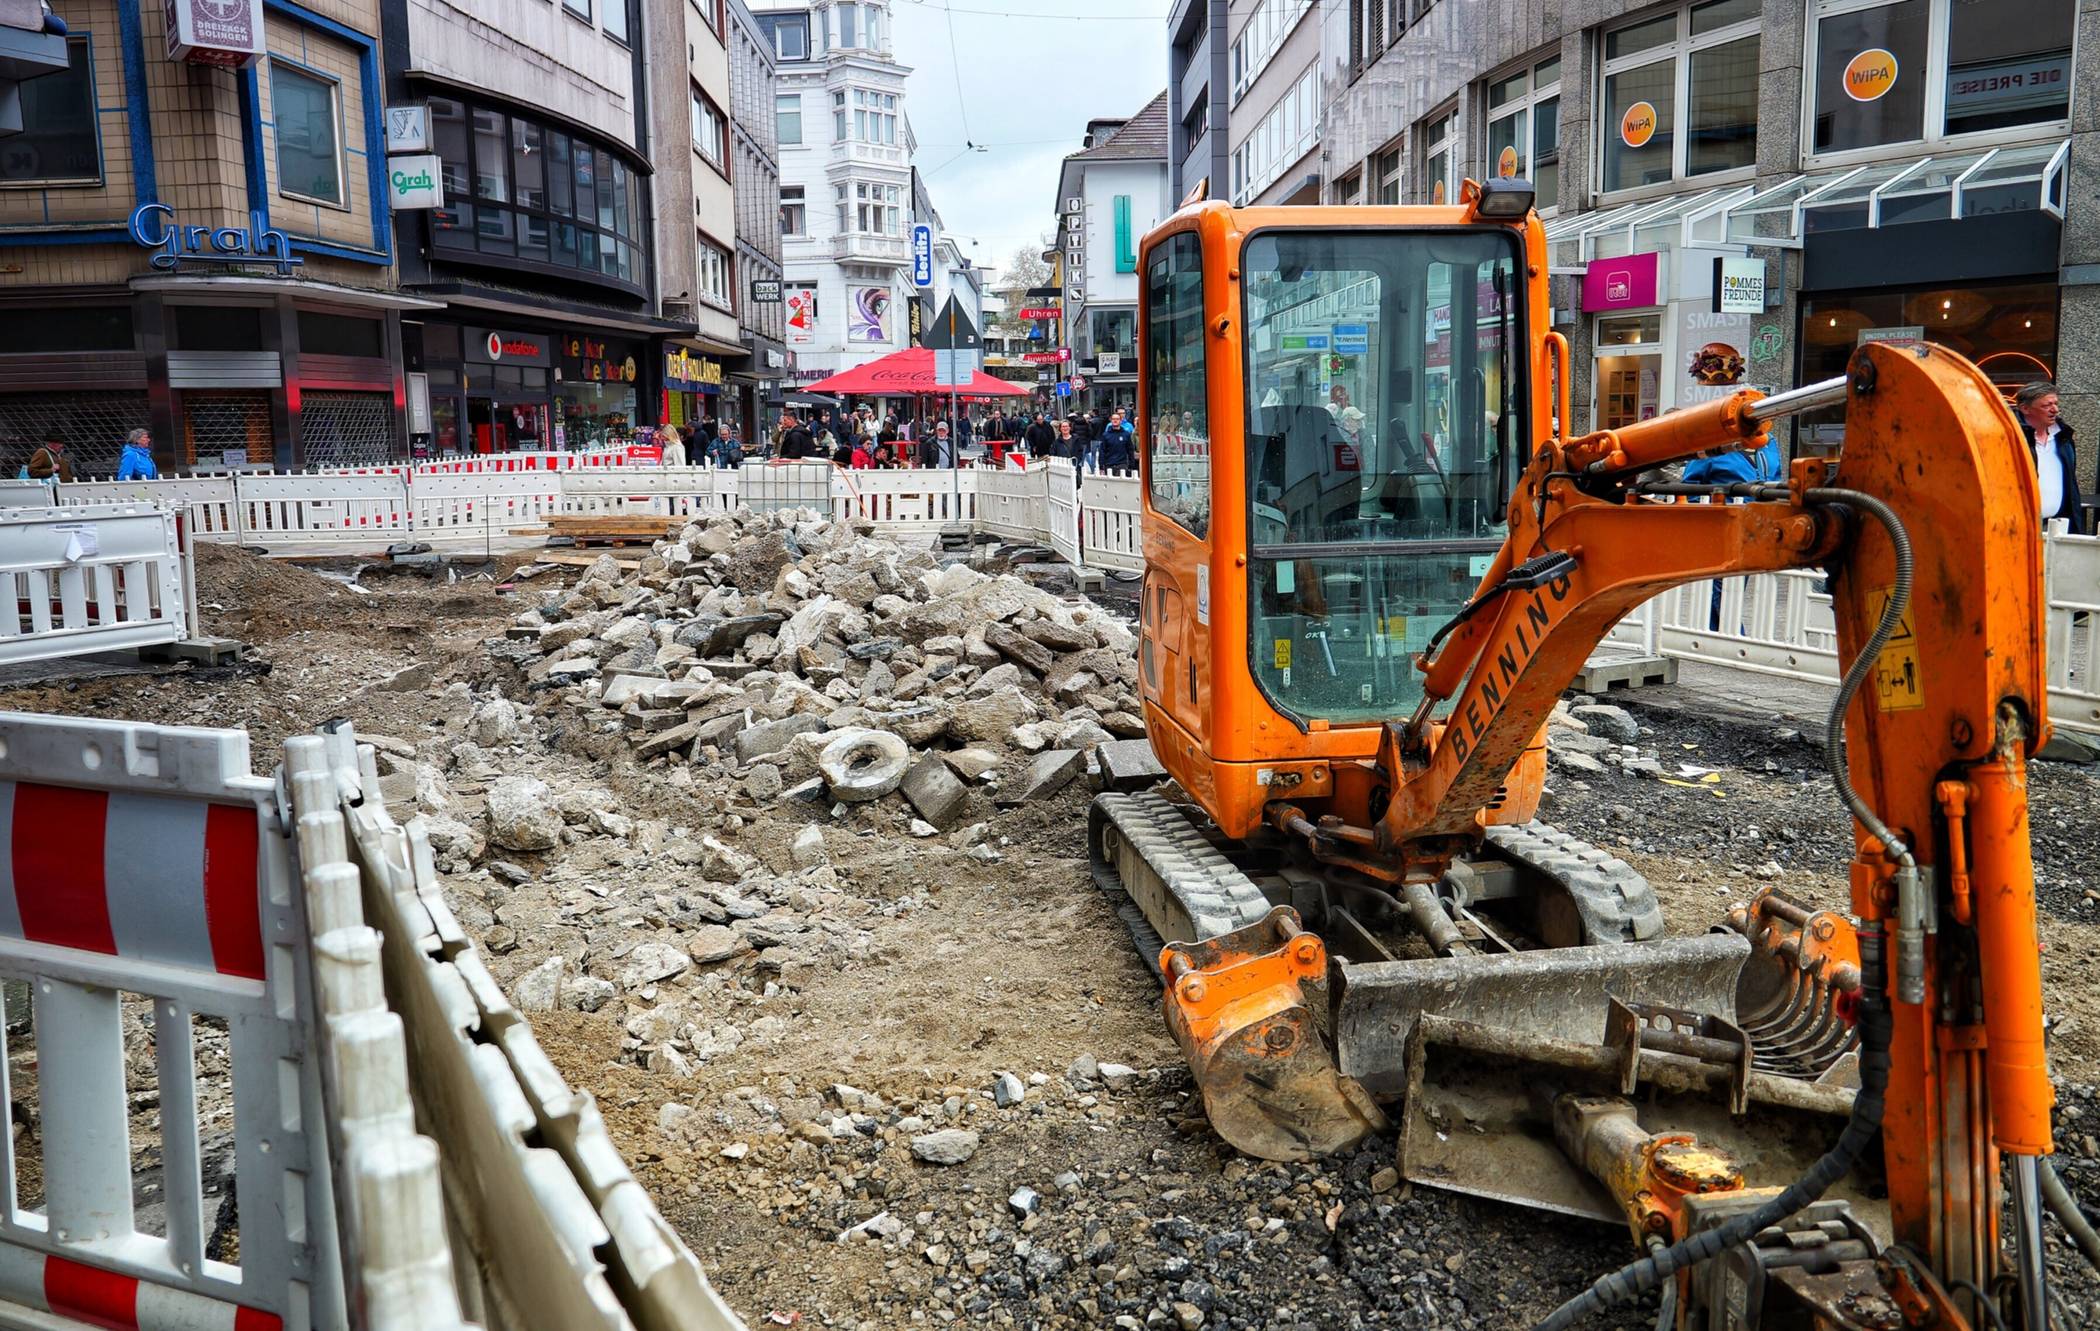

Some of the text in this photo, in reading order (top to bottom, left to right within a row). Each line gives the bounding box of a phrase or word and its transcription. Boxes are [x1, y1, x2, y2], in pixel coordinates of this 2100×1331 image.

[197, 21, 247, 34] DREIZACK
[198, 29, 248, 42] SOLINGEN
[392, 169, 434, 195] Grah
[128, 204, 304, 275] Grah
[915, 231, 929, 280] Berlitz
[756, 283, 778, 292] back
[1724, 289, 1762, 301] FREUNDE
[1028, 310, 1059, 318] Uhren
[502, 341, 540, 357] vodafone
